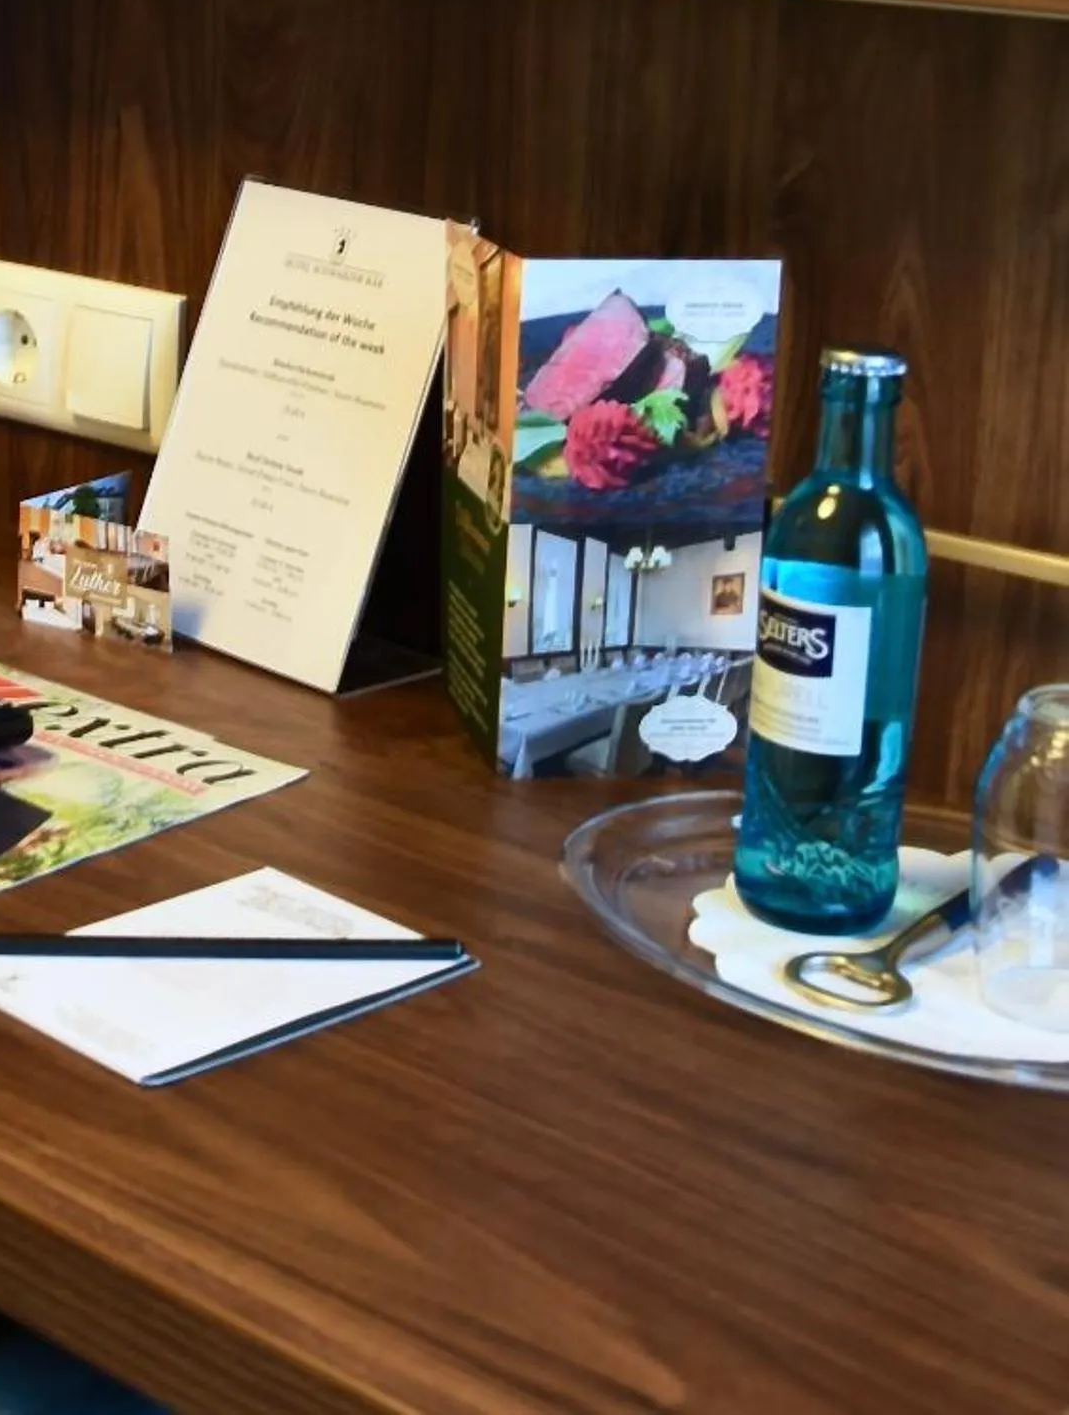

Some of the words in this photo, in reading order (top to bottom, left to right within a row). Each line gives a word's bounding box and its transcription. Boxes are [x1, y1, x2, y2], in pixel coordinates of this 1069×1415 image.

[325, 309, 341, 322] der
[249, 311, 328, 340] Recommendation
[329, 332, 342, 344] of
[342, 335, 357, 349] the
[359, 342, 385, 355] week
